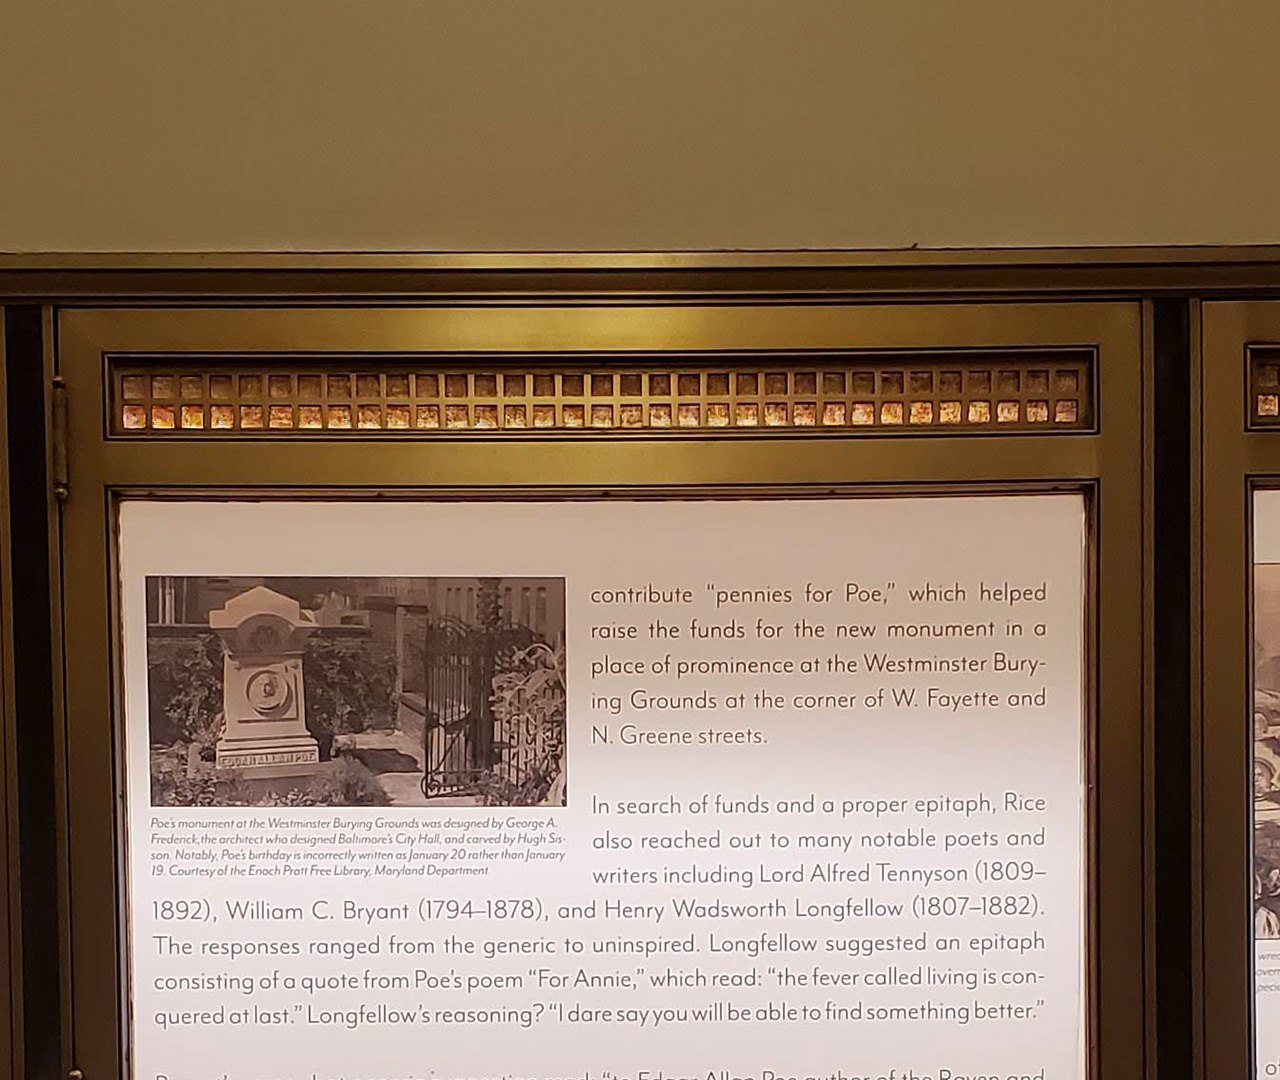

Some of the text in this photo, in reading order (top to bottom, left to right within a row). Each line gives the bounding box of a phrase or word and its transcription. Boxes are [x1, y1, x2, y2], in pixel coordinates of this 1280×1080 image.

[590, 582, 694, 605] contribute
[804, 582, 834, 603] for
[908, 581, 966, 603] which
[979, 581, 1047, 608] helped
[592, 723, 768, 745] N. Greene streets.
[592, 791, 1046, 819] In search of funds and a proper epitaph, Rice
[178, 819, 235, 829] monument
[236, 819, 247, 829] at
[249, 818, 266, 829] the
[268, 817, 331, 829] Westminster
[333, 817, 373, 832] Burying
[374, 817, 419, 829] Grounds
[421, 821, 442, 829] was
[443, 817, 490, 832] designed
[491, 817, 504, 832] by
[505, 817, 545, 832] George
[169, 865, 216, 881] Courtesy
[217, 864, 230, 876] of
[230, 865, 247, 876] the
[248, 865, 281, 876] Enoch
[283, 865, 308, 876] Pratt
[309, 865, 331, 876] Free
[374, 865, 425, 878] Maryland
[152, 898, 218, 923] 1892),
[225, 900, 303, 921] William
[311, 900, 335, 920] C.
[343, 900, 410, 926] Bryant
[557, 899, 596, 919] and
[604, 898, 665, 924] Henry
[671, 897, 787, 919] Wadsworth
[795, 896, 904, 923] Longfellow
